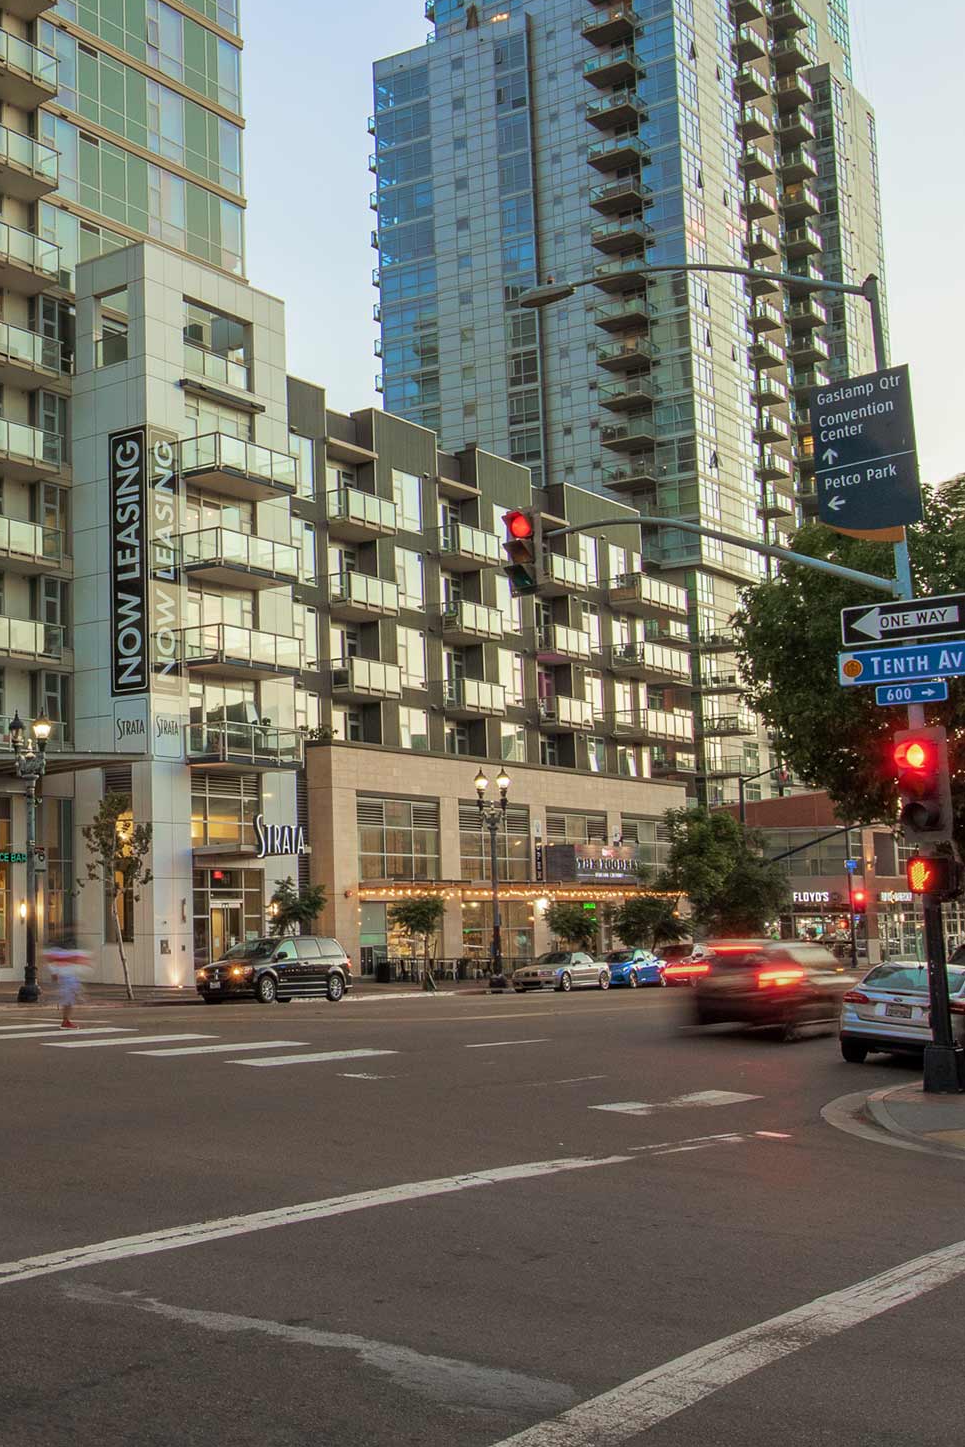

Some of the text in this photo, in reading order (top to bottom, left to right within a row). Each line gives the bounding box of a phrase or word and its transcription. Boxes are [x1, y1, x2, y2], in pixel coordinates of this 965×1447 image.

[817, 375, 900, 405] Gaslamp Qtr
[819, 400, 894, 427] Convention
[820, 423, 863, 442] Center
[825, 464, 897, 490] Petco Park
[115, 439, 142, 684] NOW LEASING
[154, 439, 176, 683] NOW LEASING
[880, 609, 947, 628] ONE WAY
[871, 655, 928, 675] TENTH
[887, 688, 911, 701] 600
[10, 853, 27, 863] BAR
[793, 891, 829, 902] FLOYD'S
